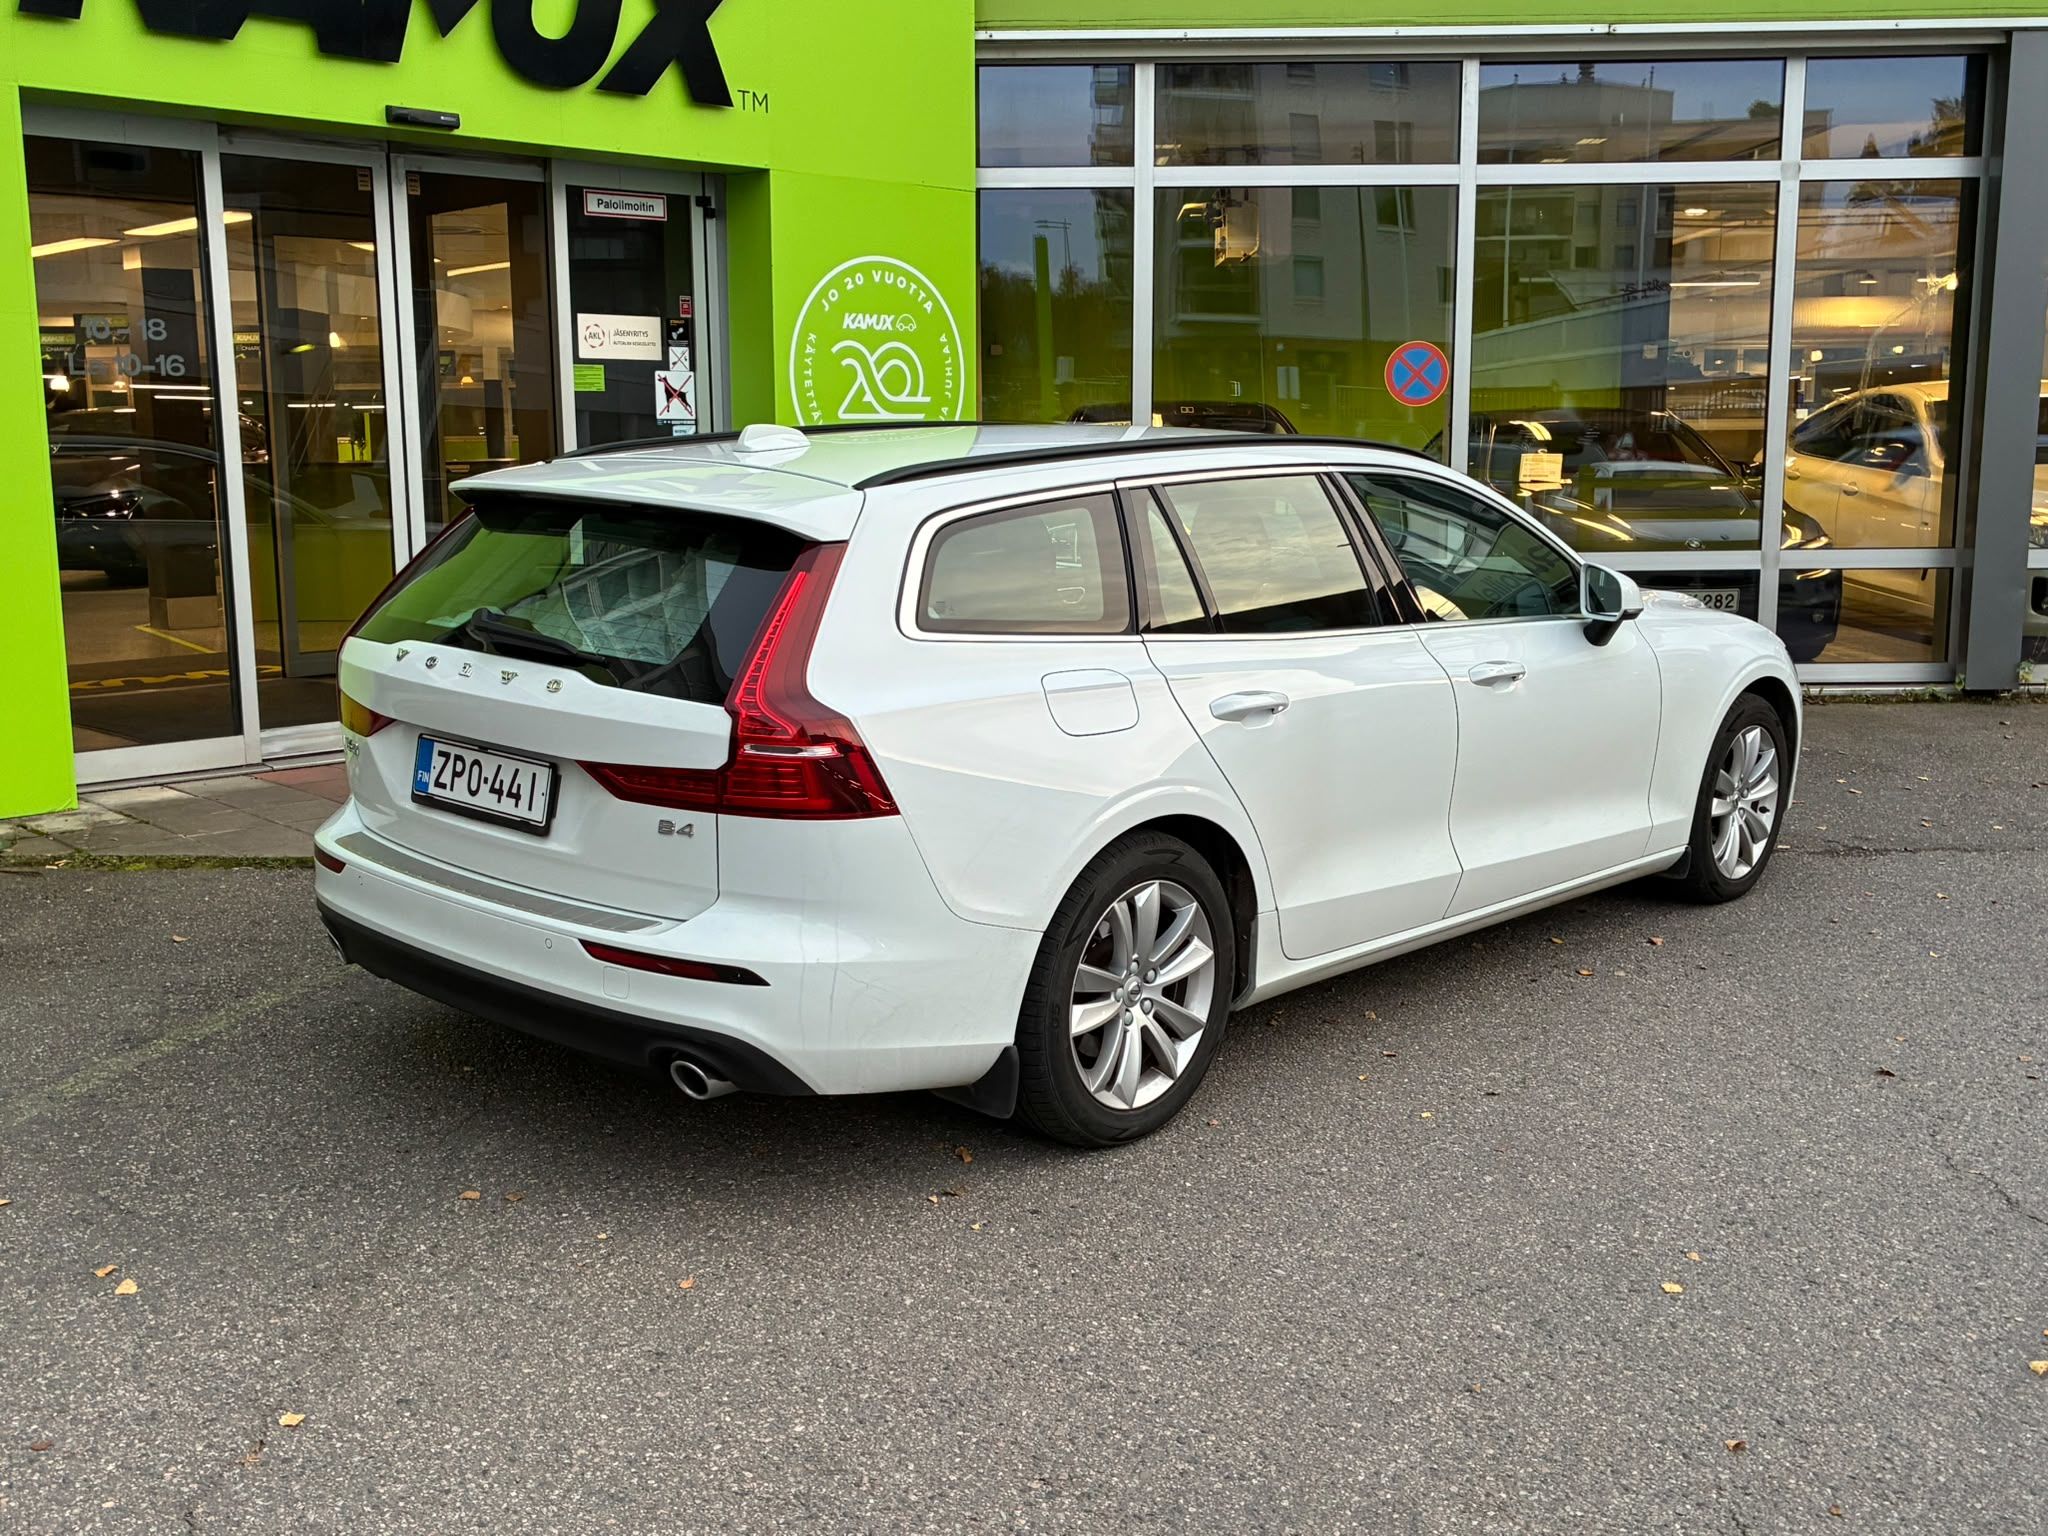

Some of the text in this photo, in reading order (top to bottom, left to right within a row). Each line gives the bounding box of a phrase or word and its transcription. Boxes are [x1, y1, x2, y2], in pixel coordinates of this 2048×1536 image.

[737, 90, 769, 114] TM
[597, 198, 655, 212] Paloilmoitin
[821, 269, 933, 314] JO 20 VUOTTA
[141, 318, 167, 341] 18
[843, 312, 895, 331] KAMUX
[588, 328, 649, 340] AKL JÄSENYRITYS
[396, 647, 564, 693] VOLVO
[417, 770, 430, 785] FIN
[434, 750, 537, 811] ZPO-441
[658, 819, 694, 838] B4
